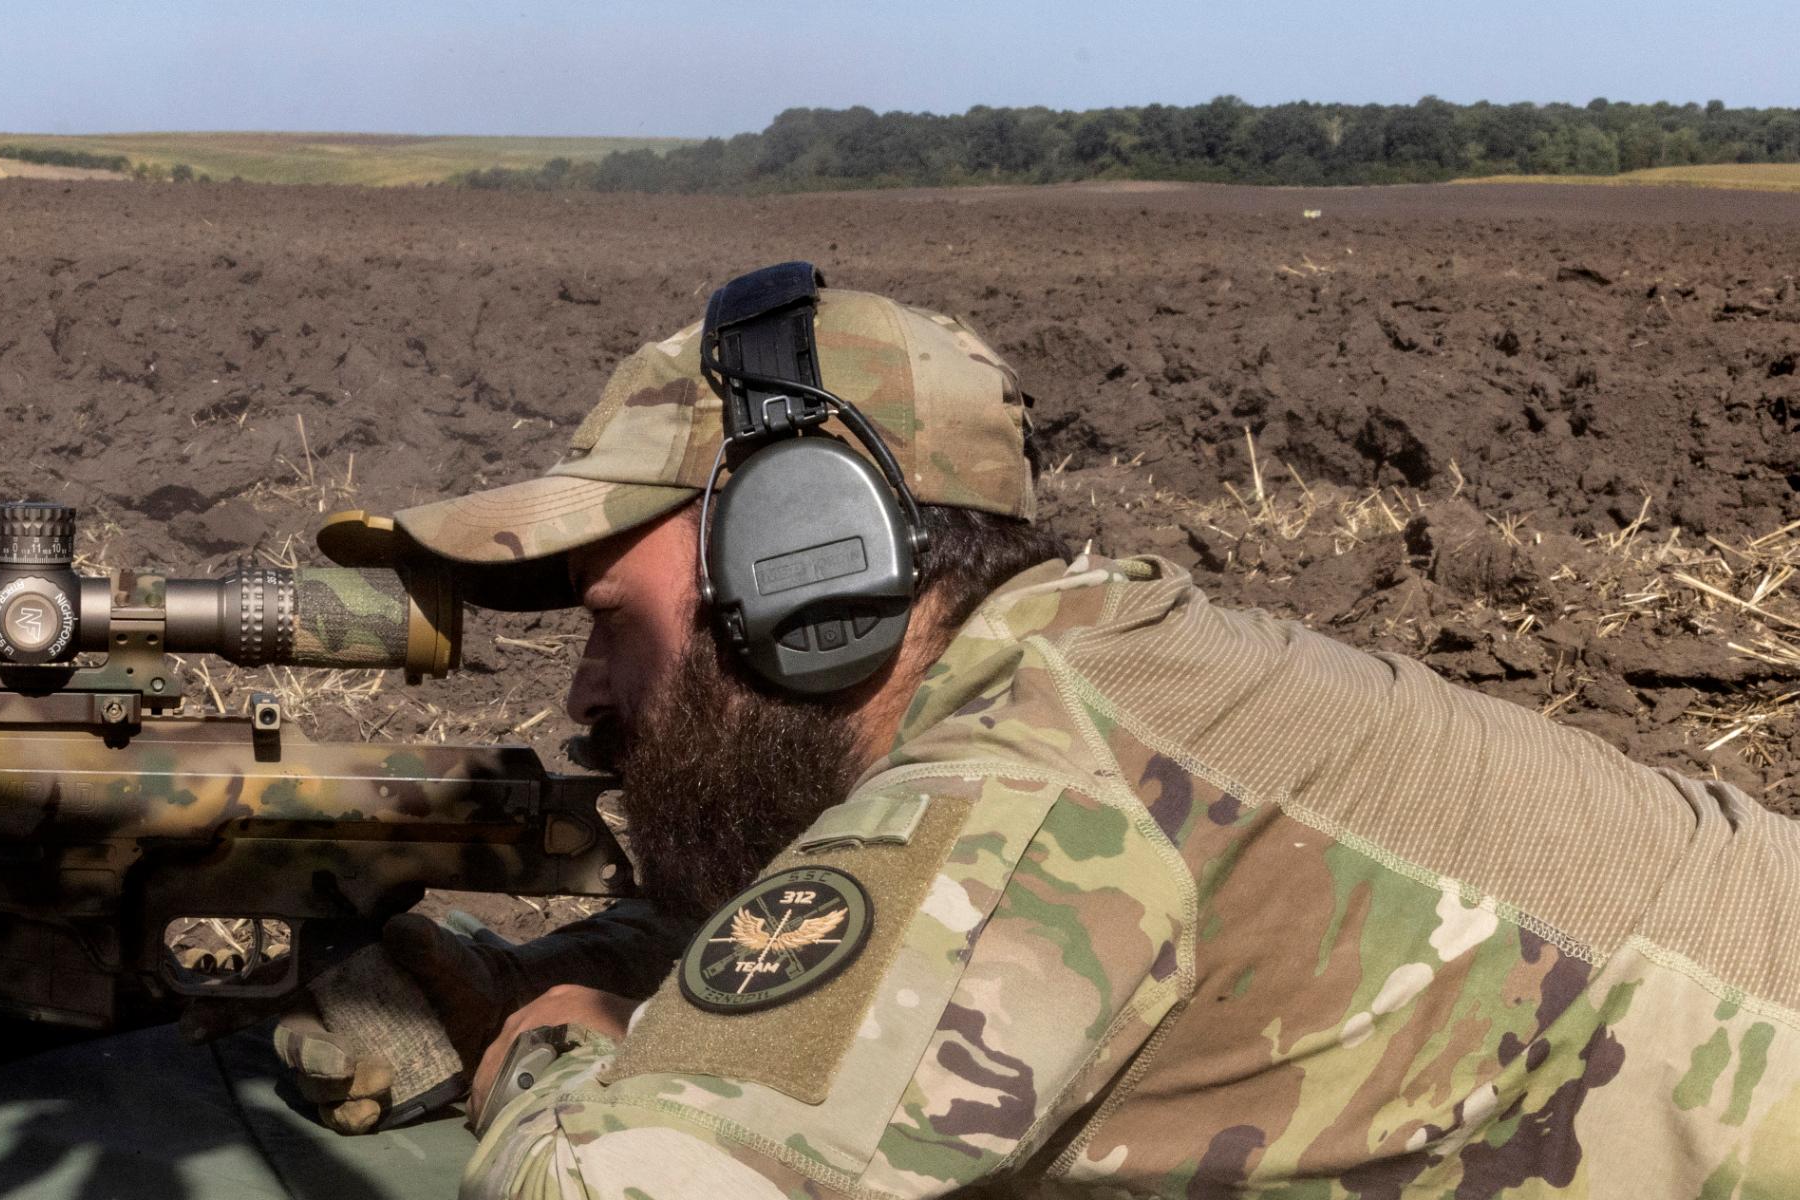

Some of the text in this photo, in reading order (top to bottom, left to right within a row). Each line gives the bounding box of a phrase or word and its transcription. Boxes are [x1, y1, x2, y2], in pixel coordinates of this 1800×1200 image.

[47, 593, 74, 657] NIGHTFORCE
[788, 870, 832, 882] SSC
[779, 890, 816, 904] 312
[735, 961, 780, 974] TEAM
